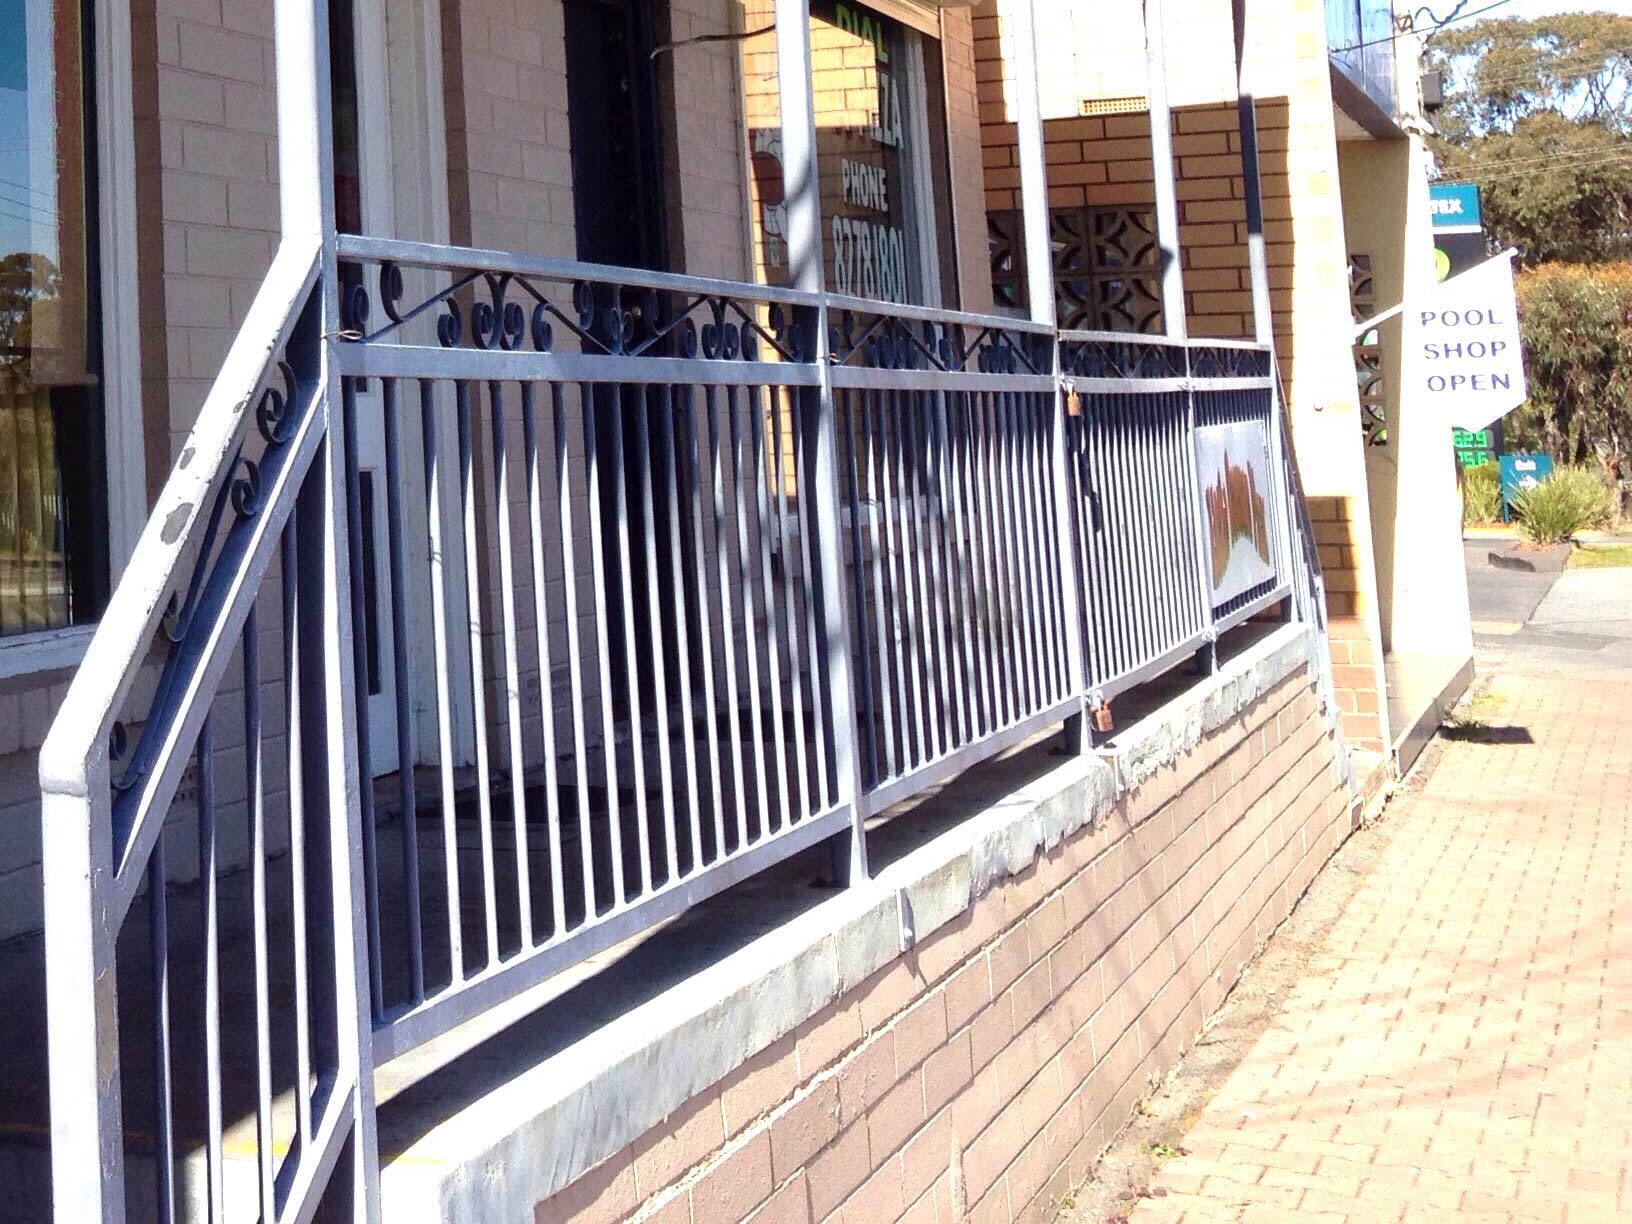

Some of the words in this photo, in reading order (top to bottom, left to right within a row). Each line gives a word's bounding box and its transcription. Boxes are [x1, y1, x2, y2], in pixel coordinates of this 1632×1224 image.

[840, 157, 889, 213] PHONE
[1420, 309, 1504, 327] POOL
[1424, 340, 1508, 360] SHOP
[1427, 371, 1511, 393] OPEN
